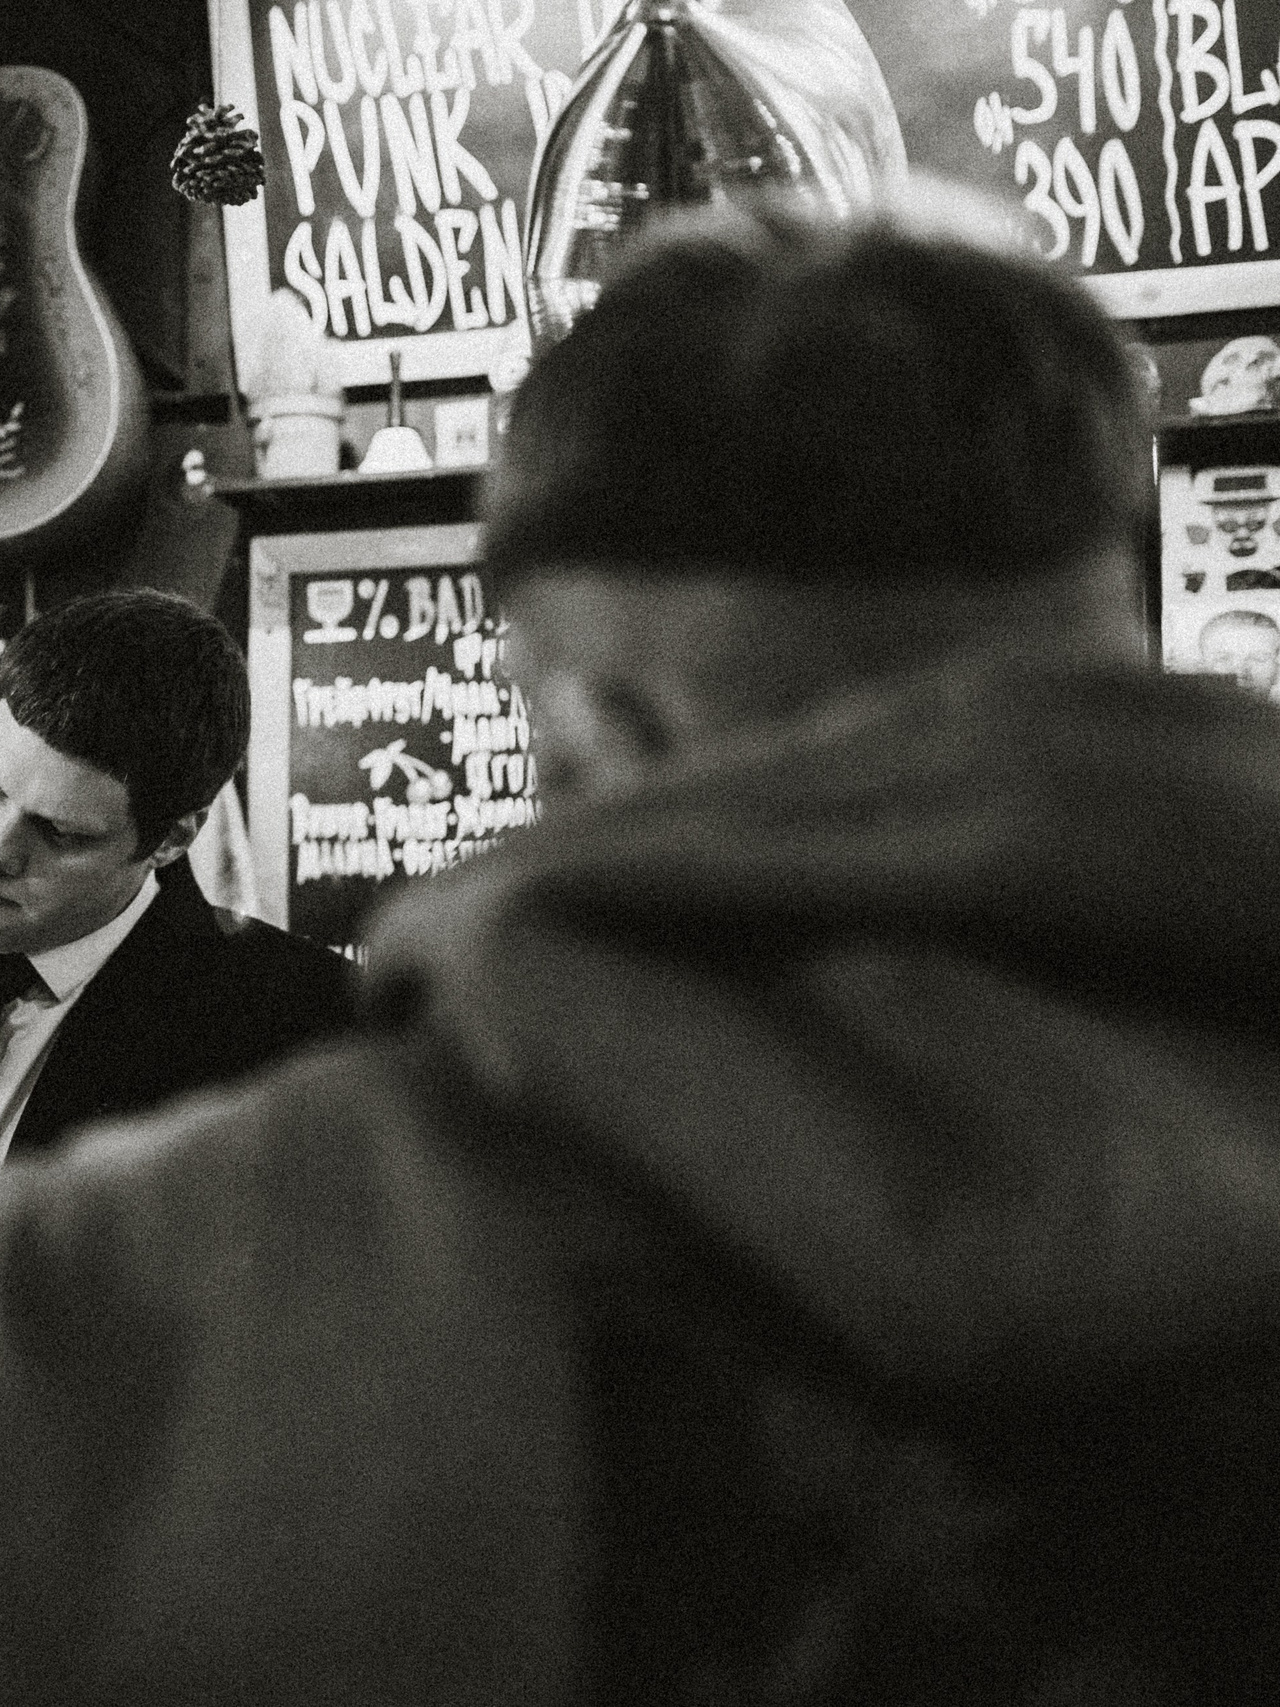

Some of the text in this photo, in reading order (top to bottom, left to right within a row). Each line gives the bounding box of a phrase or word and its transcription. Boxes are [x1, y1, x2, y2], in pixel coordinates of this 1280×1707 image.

[268, 0, 543, 105] NUCLEAR
[1010, 8, 1141, 134] 540
[1167, 0, 1280, 123] BL
[279, 87, 499, 218] PUNK
[1014, 136, 1144, 267] 390
